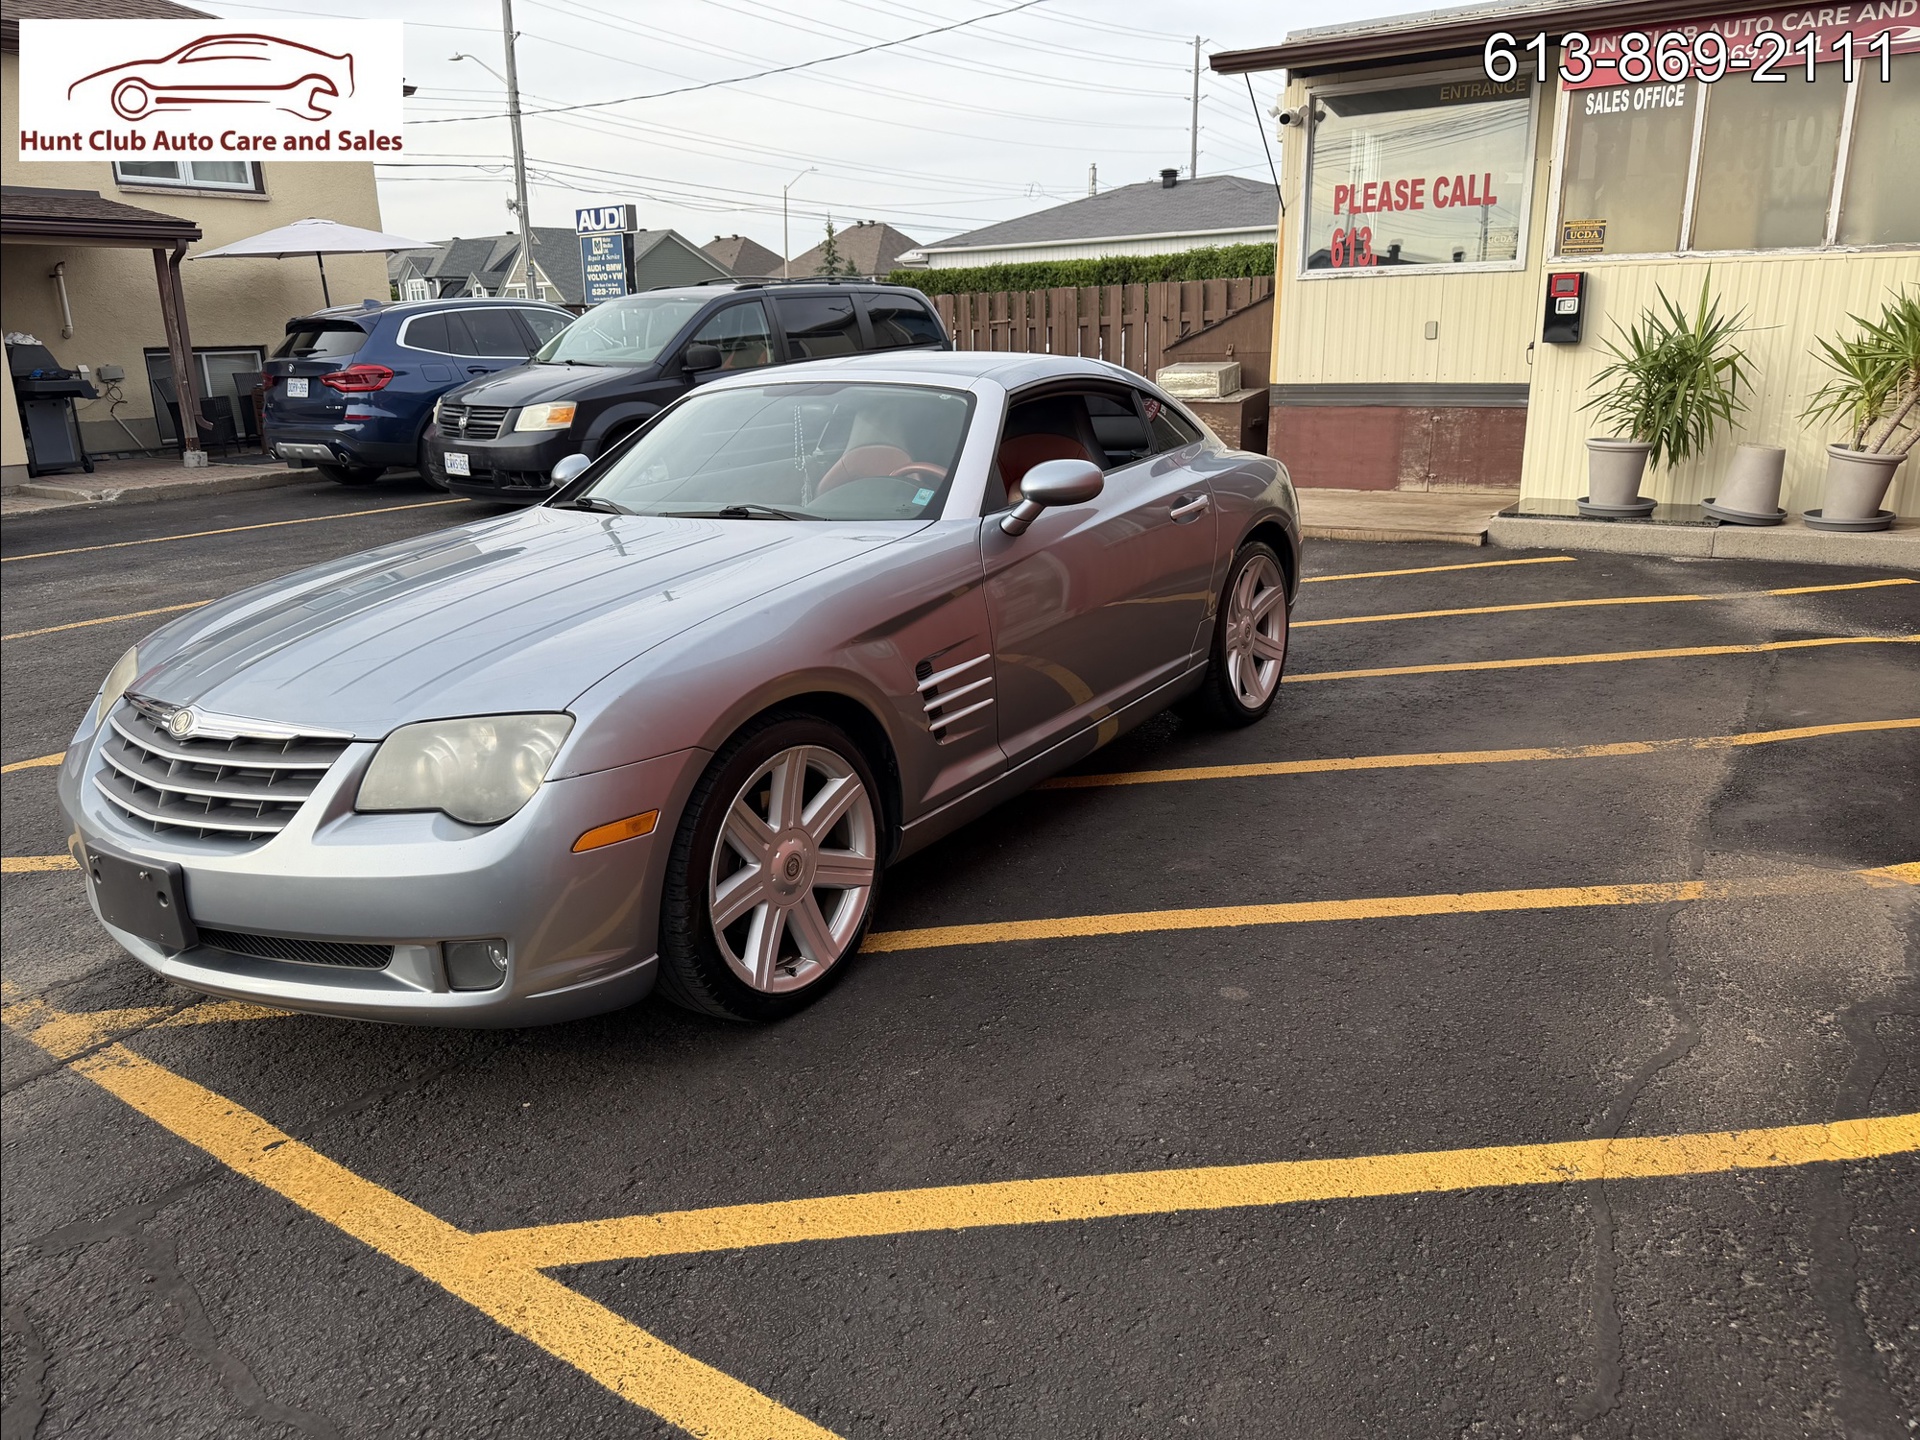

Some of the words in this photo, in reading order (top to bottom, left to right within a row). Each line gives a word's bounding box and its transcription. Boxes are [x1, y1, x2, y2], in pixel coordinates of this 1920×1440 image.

[1781, 6, 1851, 31] CARE
[1856, 0, 1918, 23] AND
[1440, 78, 1527, 100] ENTRANCE
[1585, 89, 1630, 116] SALES
[1633, 84, 1686, 111] OFFICE
[1333, 178, 1425, 216] PLEASE
[1432, 172, 1498, 209] CALL
[579, 207, 625, 231] AUDI
[1569, 230, 1600, 239] UCDA
[587, 264, 602, 273] AUDI
[606, 263, 622, 272] BMW
[587, 272, 608, 282] VOLVO
[612, 272, 623, 281] VW
[591, 288, 621, 296] 523-7711
